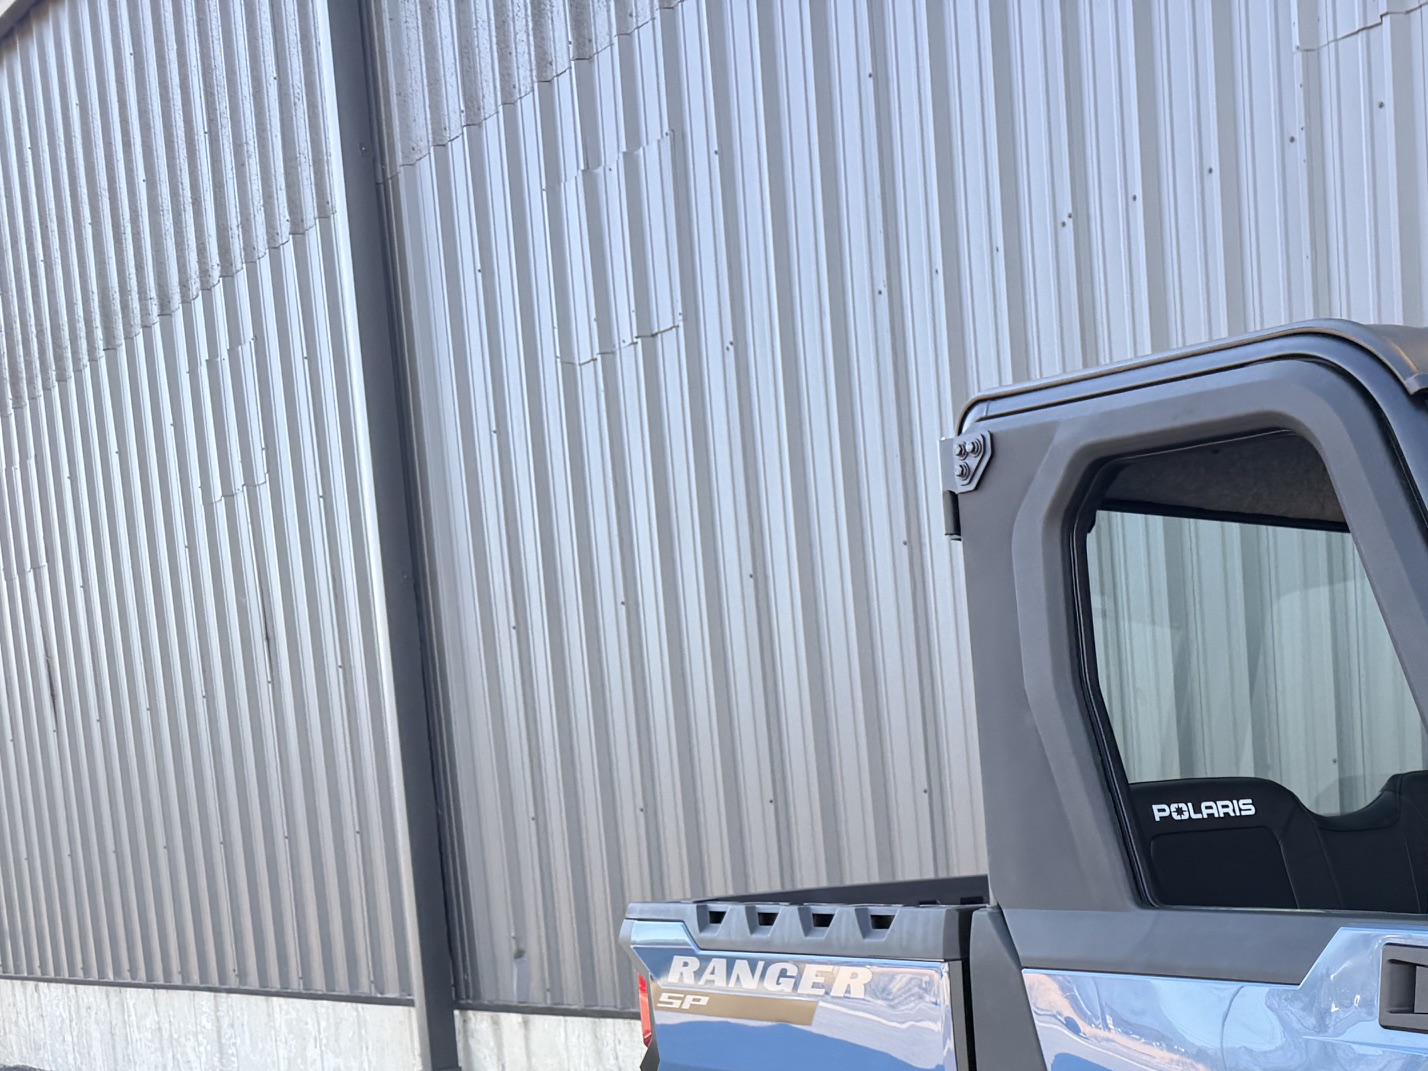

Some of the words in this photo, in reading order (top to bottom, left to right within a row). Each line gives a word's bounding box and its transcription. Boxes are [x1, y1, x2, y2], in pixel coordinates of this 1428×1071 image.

[1152, 798, 1256, 821] POLARIS
[667, 955, 873, 999] RANGER
[656, 992, 710, 1010] SP
